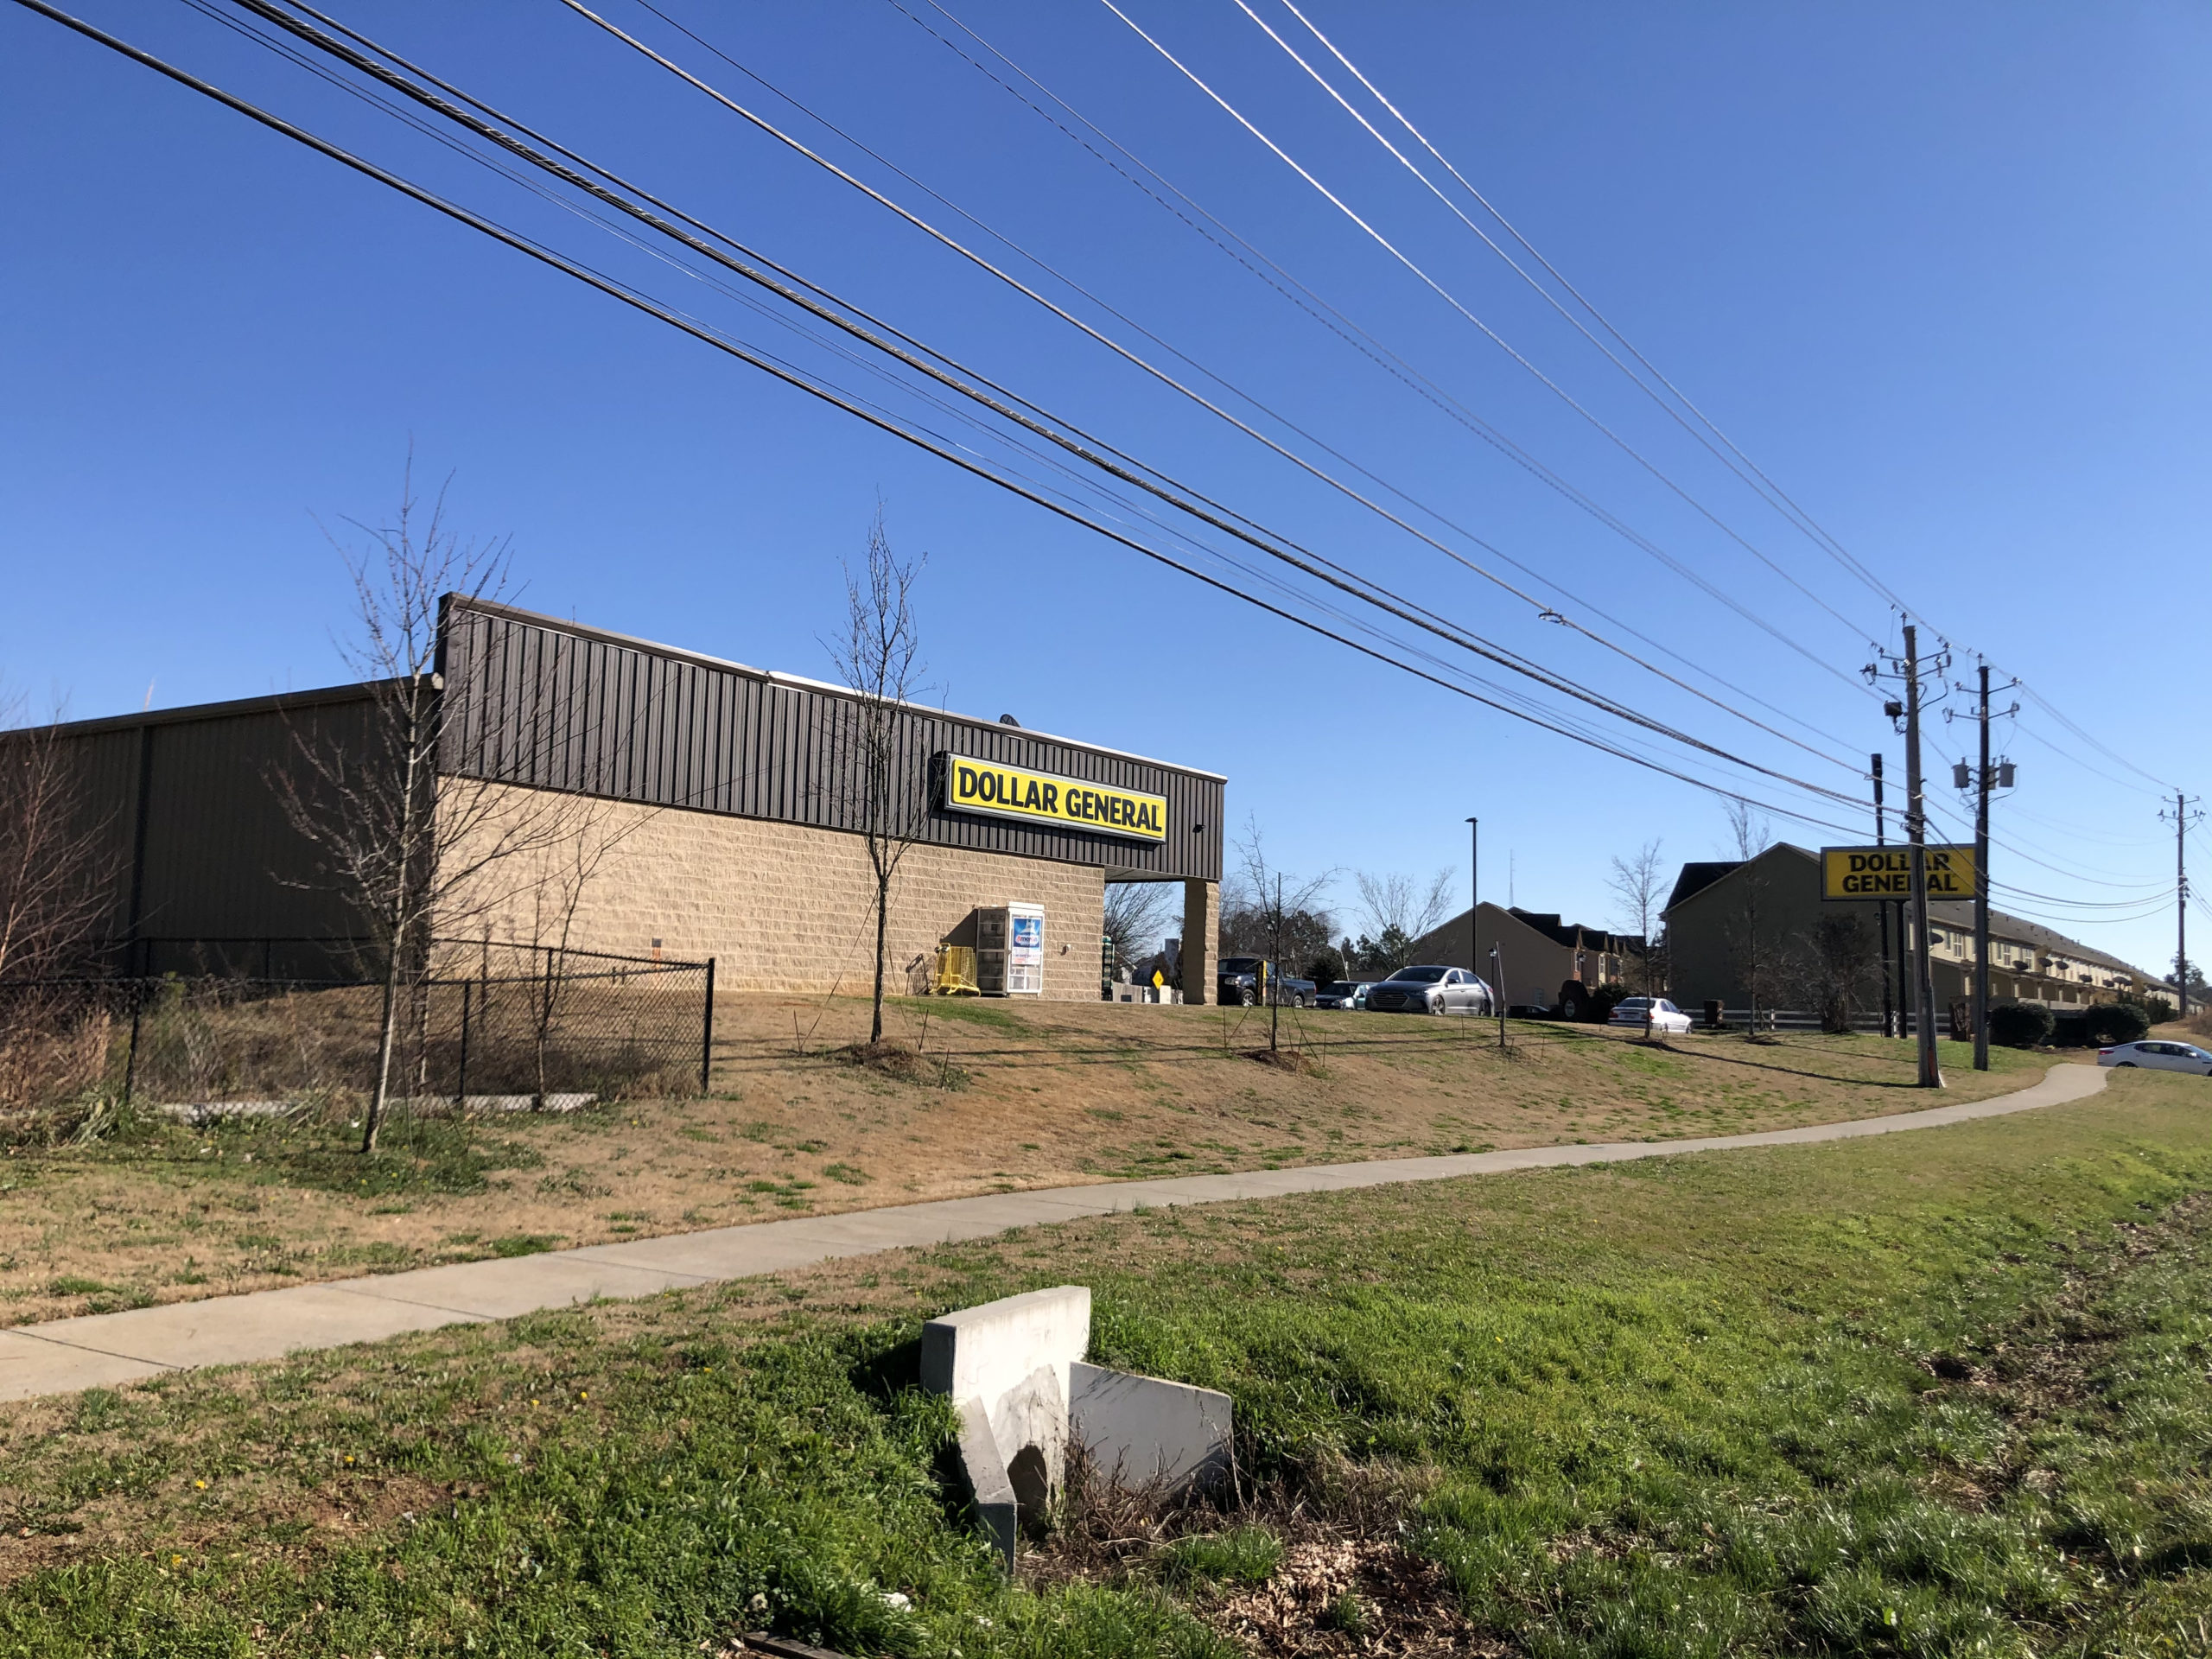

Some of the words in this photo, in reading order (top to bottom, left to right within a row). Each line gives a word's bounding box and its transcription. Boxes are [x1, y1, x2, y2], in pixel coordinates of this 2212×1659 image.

[958, 766, 1058, 814] DOLLAR
[1065, 788, 1162, 832] GENERAL
[1842, 874, 1958, 893] GENEAL
